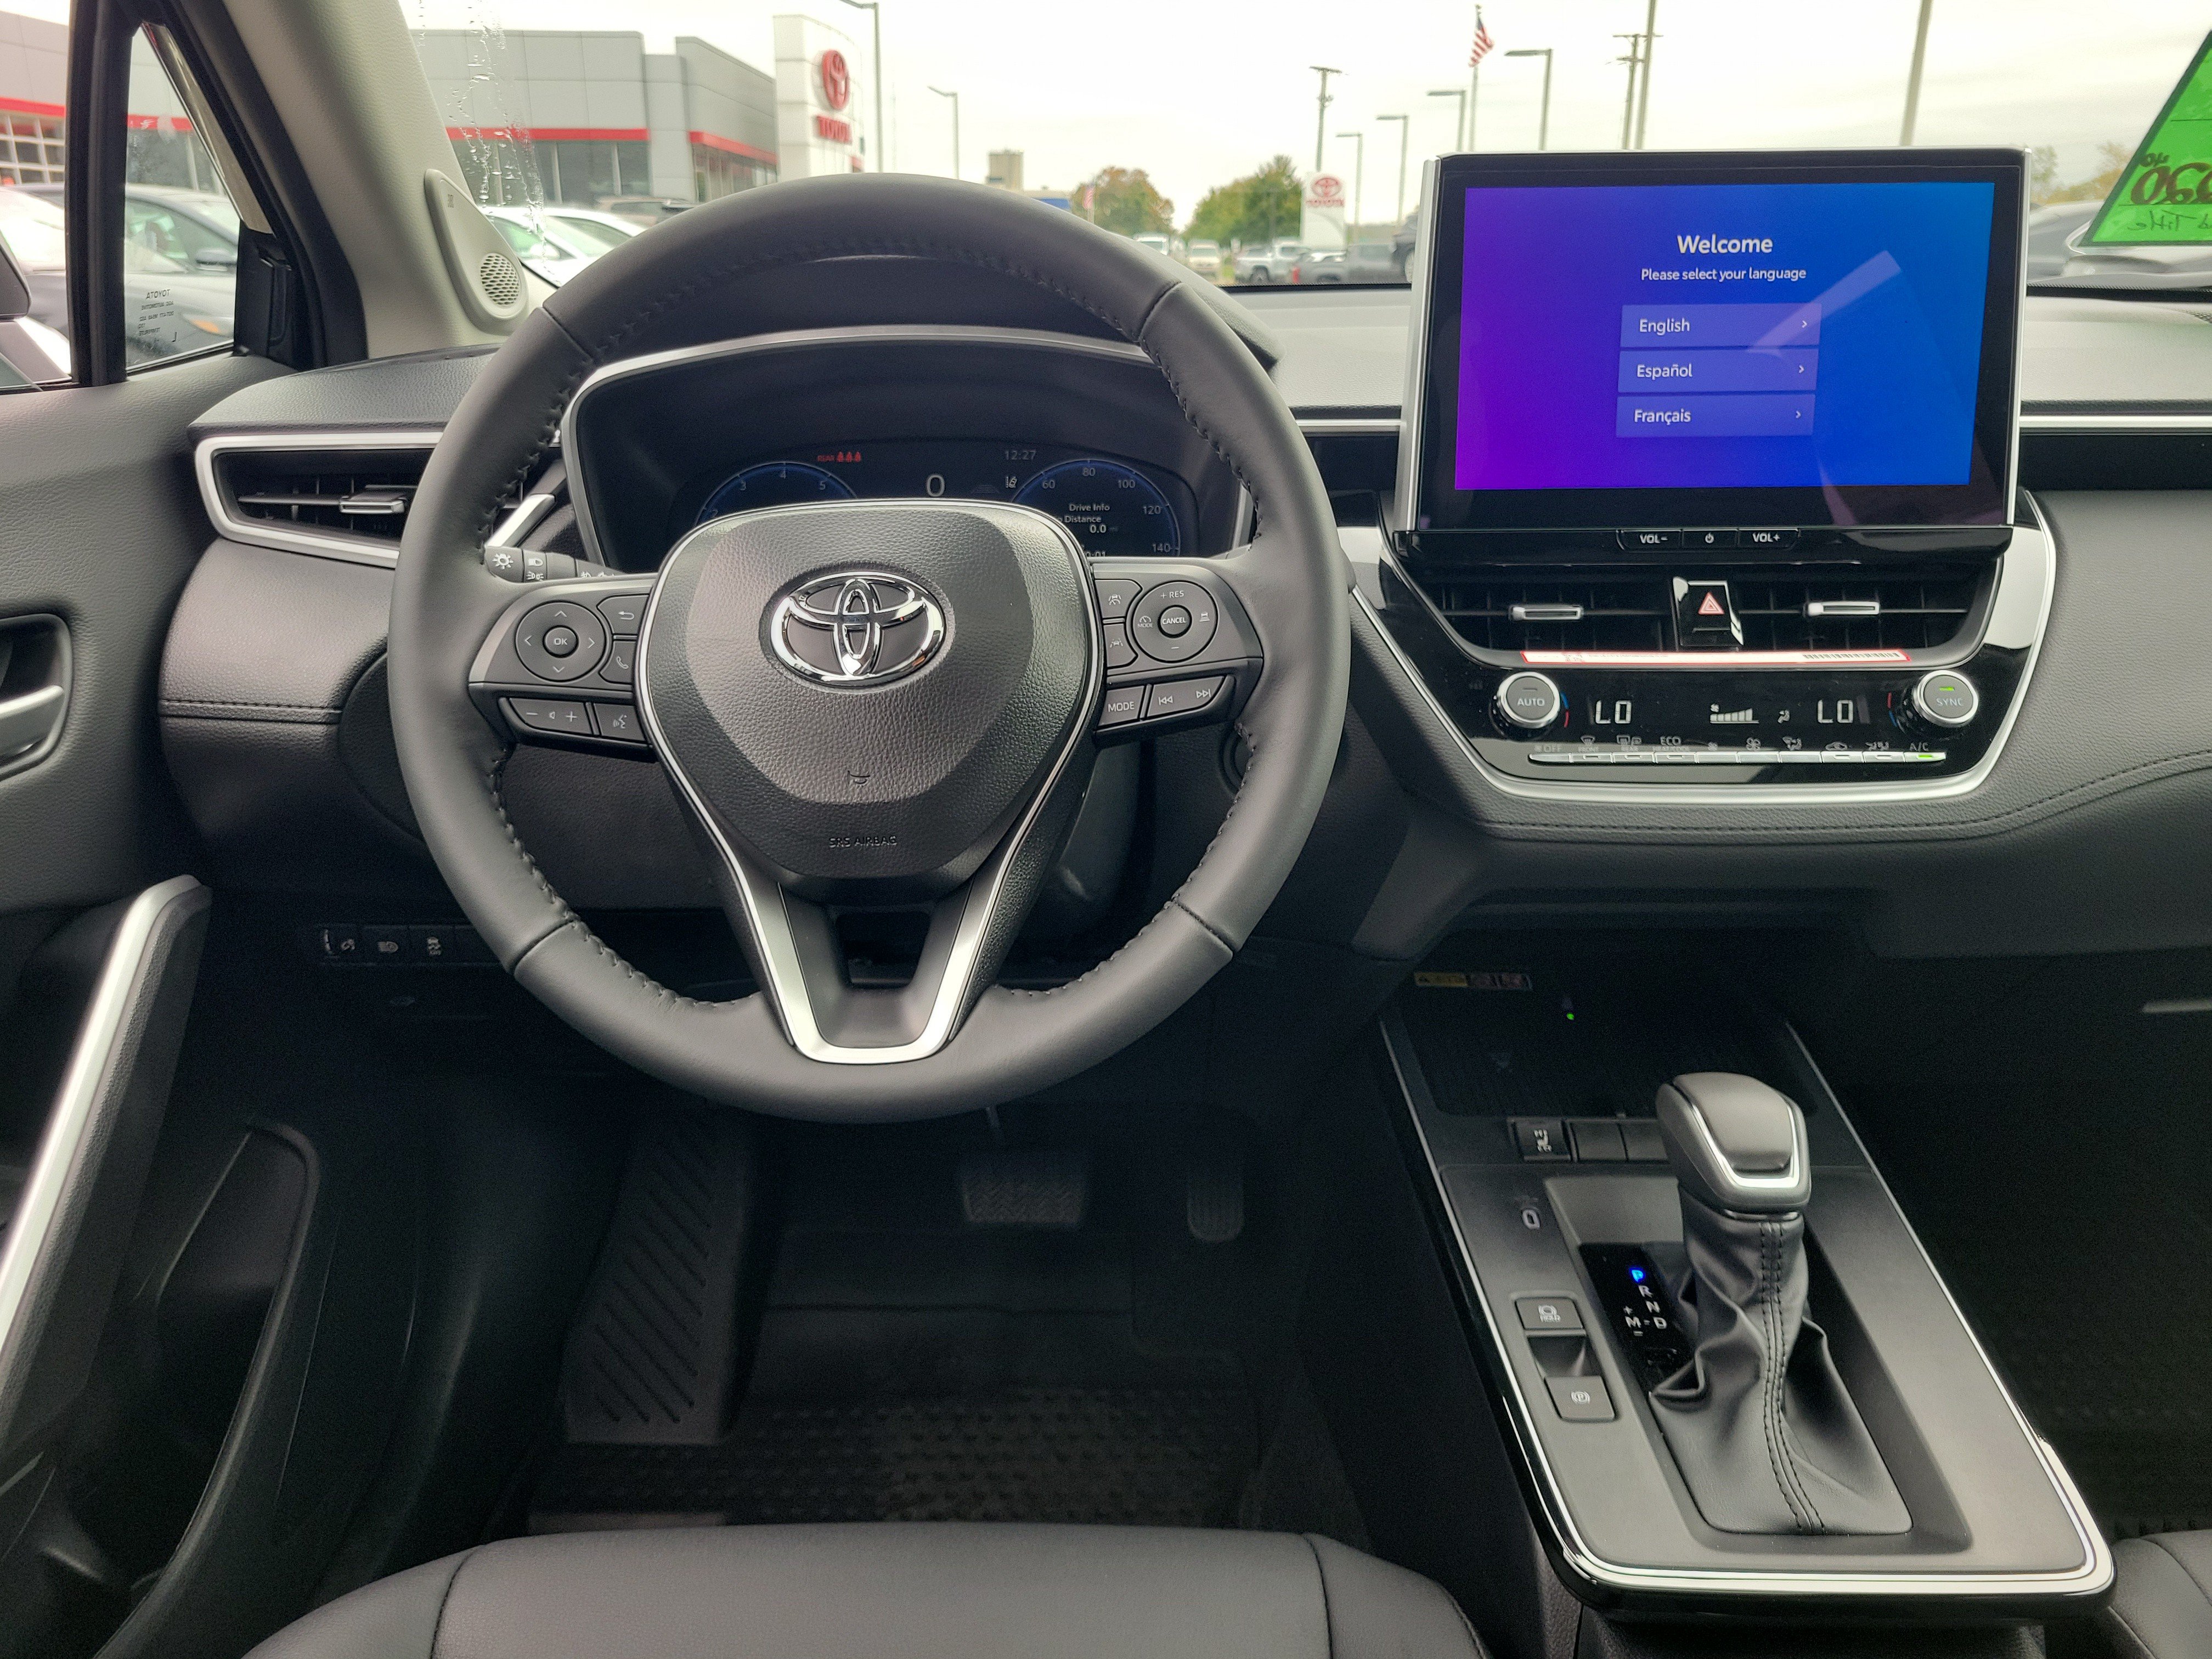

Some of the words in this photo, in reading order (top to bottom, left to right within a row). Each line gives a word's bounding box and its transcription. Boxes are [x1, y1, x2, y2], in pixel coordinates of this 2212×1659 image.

[1677, 234, 1773, 253] Welcome
[1641, 268, 1680, 280] Please
[1682, 268, 1717, 280] select
[1719, 270, 1746, 282] your
[1749, 267, 1807, 281] language
[1639, 318, 1690, 335] English
[1637, 364, 1692, 380] Español
[1634, 408, 1691, 425] Français
[1005, 450, 1036, 460] 12:27
[780, 470, 786, 479] 4
[1082, 467, 1095, 476] 80
[740, 481, 747, 490] 3
[820, 481, 826, 490] 5
[926, 474, 945, 496] 0
[1042, 480, 1056, 489] 60
[1118, 479, 1135, 488] 100
[1143, 506, 1161, 515] 120
[1090, 524, 1107, 533] 0.0
[1152, 543, 1170, 552] 140
[1108, 701, 1135, 712] MODE
[1517, 698, 1545, 707] AUTO
[1936, 697, 1963, 707] SYNC
[1596, 700, 1632, 724] LO
[1818, 699, 1854, 723] LO
[1660, 736, 1681, 745] ECO
[1910, 742, 1928, 751] A/C
[829, 837, 850, 848] SRS
[854, 836, 897, 847] AIRBAG
[1638, 1285, 1654, 1297] R
[1646, 1301, 1660, 1313] N
[1625, 1316, 1641, 1328] M
[1654, 1317, 1667, 1329] D
